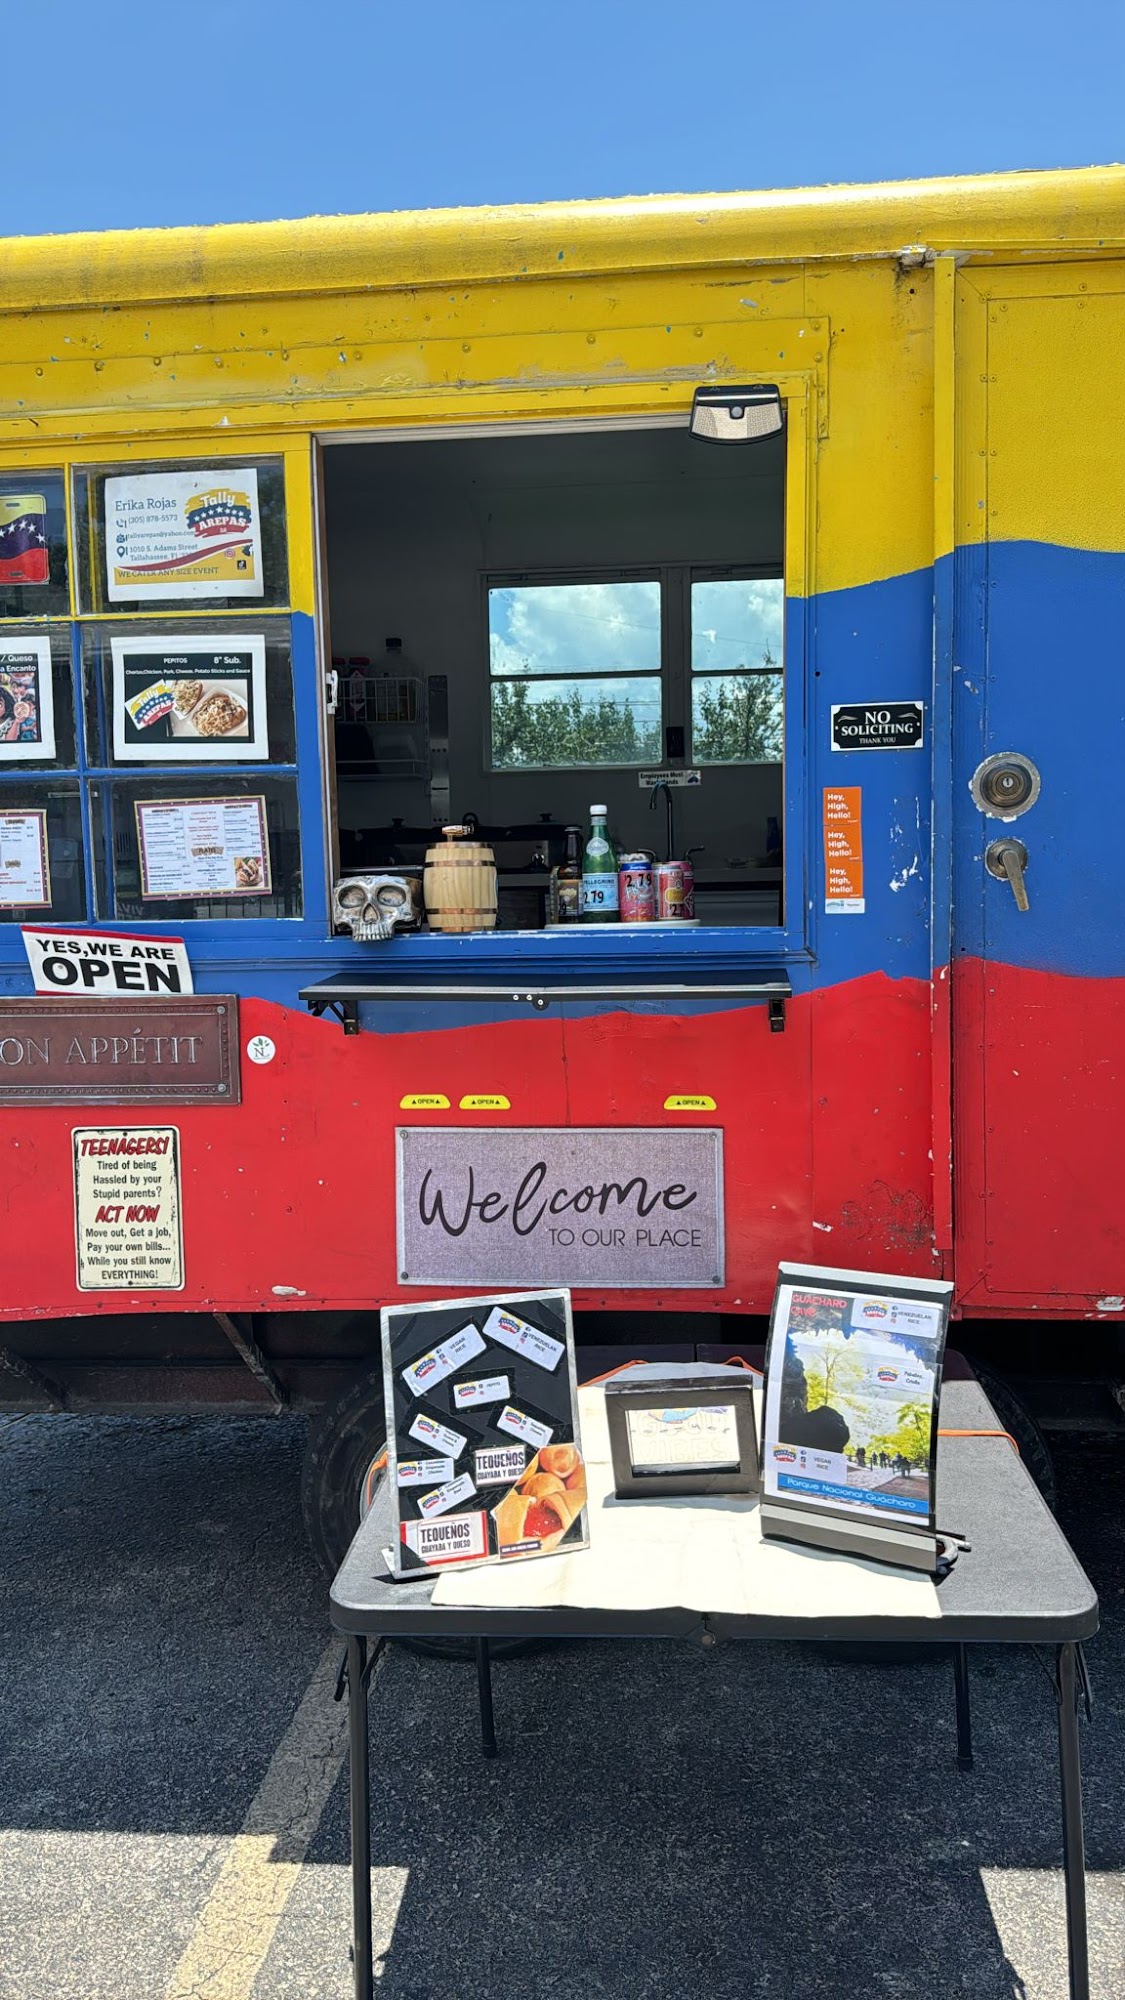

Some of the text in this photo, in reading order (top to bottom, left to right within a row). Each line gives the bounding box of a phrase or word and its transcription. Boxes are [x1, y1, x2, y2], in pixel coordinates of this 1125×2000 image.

[115, 497, 177, 511] Erika Rojas
[200, 491, 235, 507] Tally
[199, 516, 247, 530] AREPAS
[153, 544, 177, 552] Adams
[178, 543, 198, 551] Street
[193, 566, 219, 575] EVENT
[8, 654, 33, 662] Queso
[223, 656, 242, 664] Sub.
[6, 664, 37, 672] Encanto
[865, 710, 891, 724] NO
[841, 723, 914, 736] SOLICITING
[827, 811, 851, 819] Hello!
[828, 849, 852, 857] Hello!
[829, 885, 853, 894] Hello!
[130, 947, 176, 960] ARE
[42, 956, 182, 993] OPEN
[0, 1026, 203, 1066] ON APPÉTIT
[81, 1136, 170, 1156] TEENAGERS!
[97, 1160, 157, 1171] Tired of being
[93, 1175, 162, 1186] Hassled by your
[93, 1186, 162, 1200] Stupid parents?
[419, 1161, 698, 1237] Welcome
[95, 1204, 161, 1223] ACT NOW
[86, 1228, 108, 1238] Move
[110, 1228, 127, 1239] out,
[129, 1227, 145, 1237] Get
[549, 1228, 701, 1247] TO OUR PLACE
[87, 1242, 102, 1254] Pay
[105, 1243, 122, 1254] your
[125, 1243, 143, 1251] own
[87, 1256, 171, 1267] While you still know
[101, 1270, 159, 1280] EVERYTHING!
[449, 1337, 466, 1350] VEGAN
[455, 1344, 466, 1354] RICE
[528, 1333, 557, 1352] VENEZUELAN
[534, 1343, 546, 1353] RICE
[476, 1450, 524, 1470] TEQUEÑOS
[787, 1478, 819, 1491] Parque
[822, 1484, 863, 1499] Nacional
[421, 1522, 470, 1543] TEQUEÑOS
[447, 1541, 452, 1550] Y
[453, 1539, 471, 1550] QUESO
